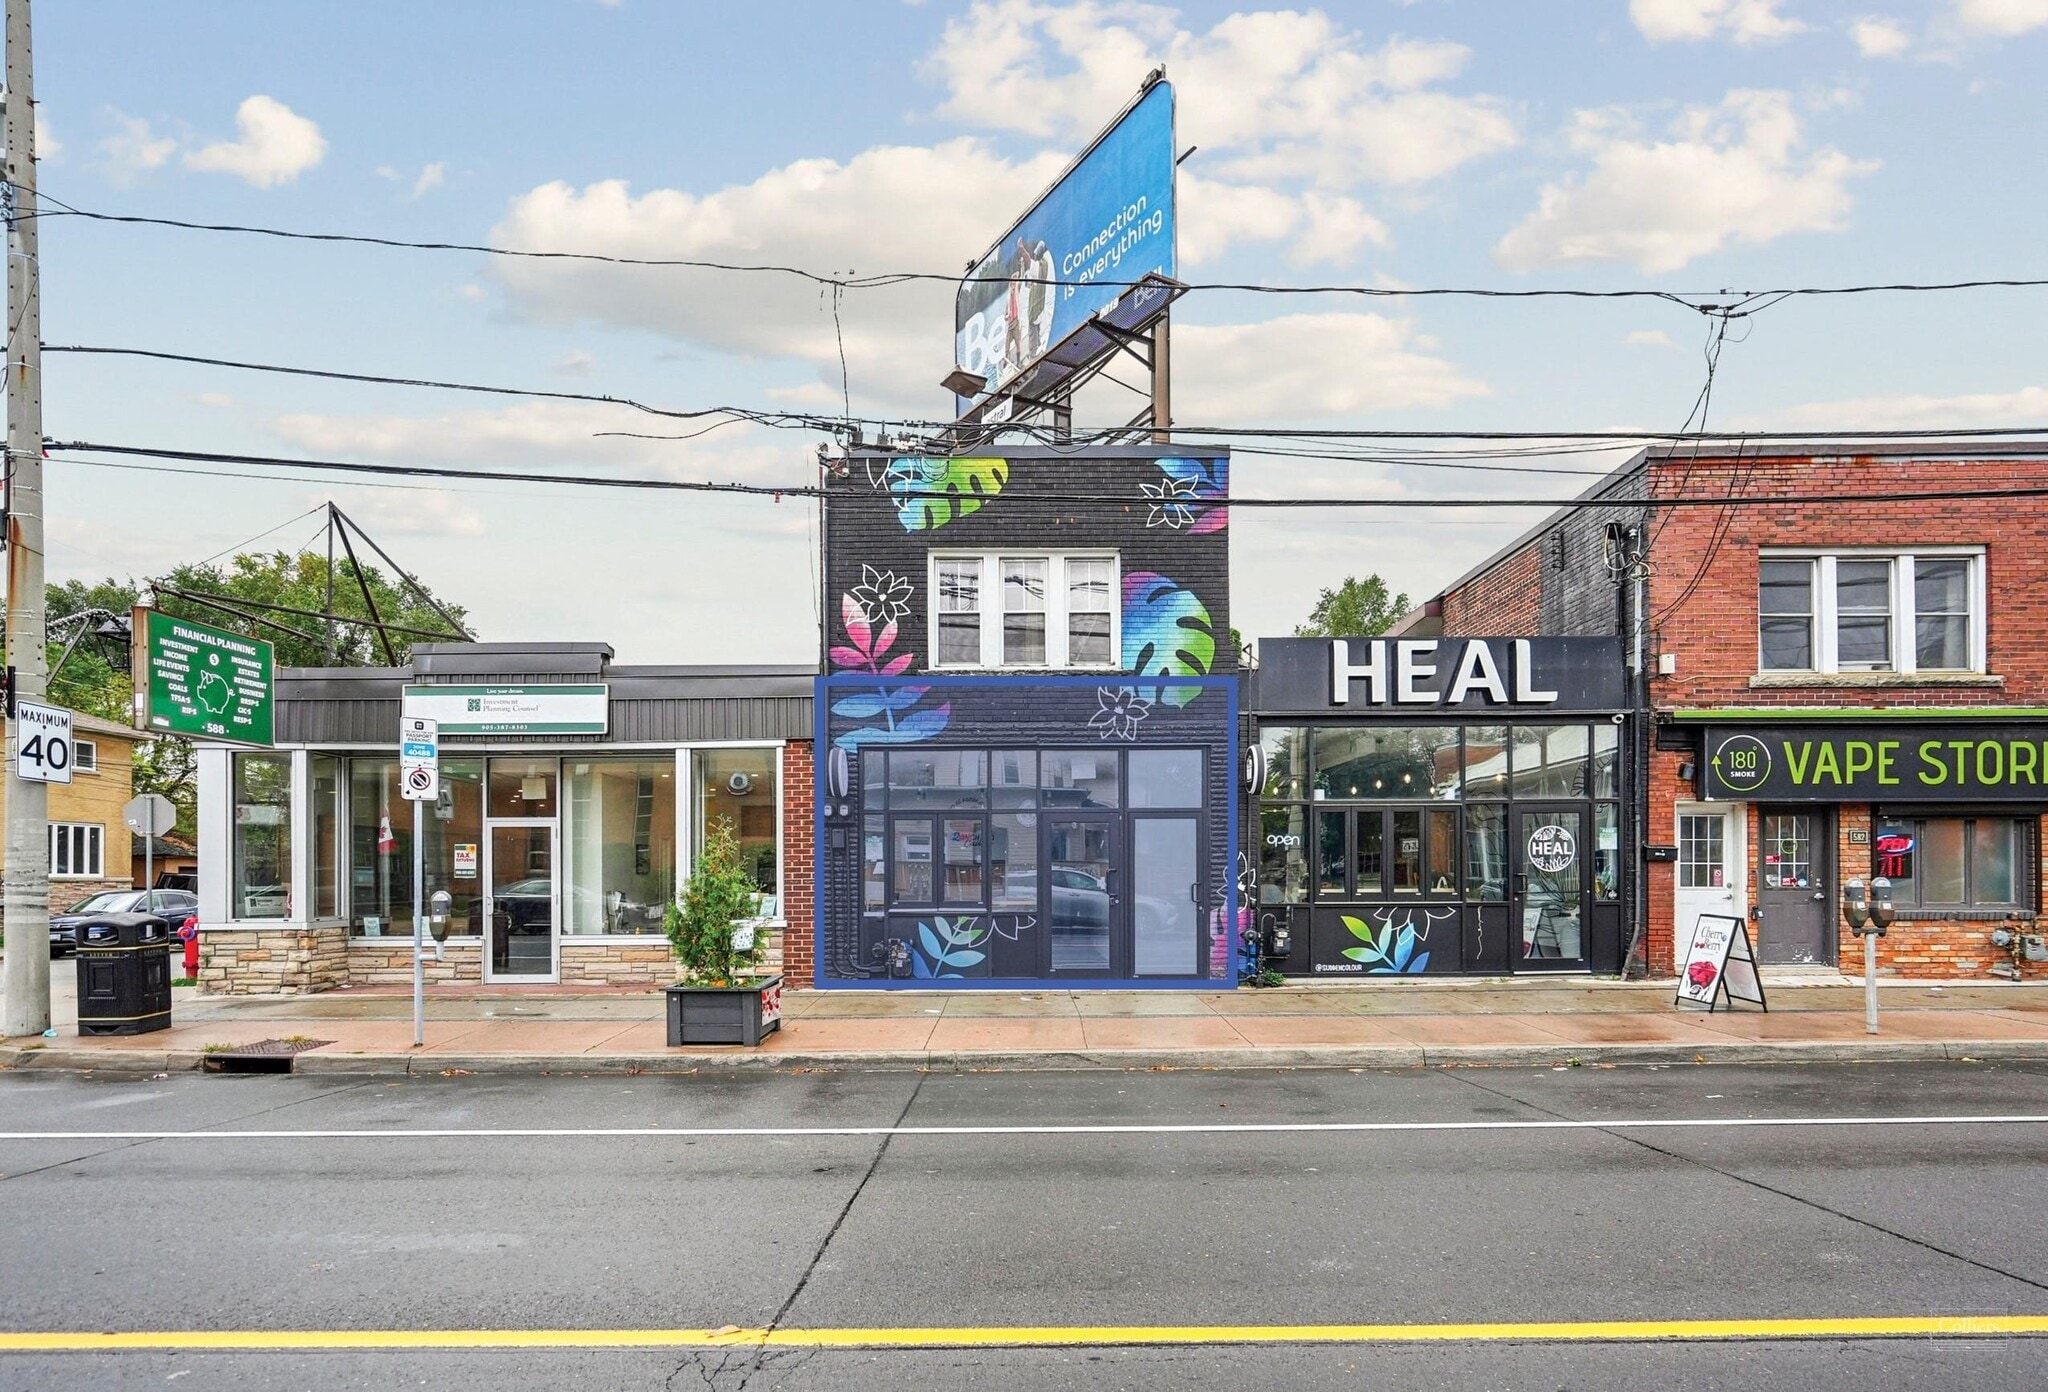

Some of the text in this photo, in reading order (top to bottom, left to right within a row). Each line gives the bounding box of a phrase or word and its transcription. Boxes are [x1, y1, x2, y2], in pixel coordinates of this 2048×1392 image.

[1063, 195, 1146, 275] Connection
[1064, 209, 1162, 301] is everything
[159, 637, 199, 654] INVESTMENT
[173, 626, 256, 656] FINANCIAL PLANNING
[163, 649, 188, 662] INCOME
[231, 655, 262, 670] INSURANCE
[153, 657, 190, 672] LIFE EVENTS
[1333, 639, 1558, 703] HEAL
[157, 669, 184, 682] SAVINGS
[238, 667, 260, 678] ESTATES
[168, 682, 188, 693] GOALS
[233, 676, 267, 690] RETIREMENT
[239, 687, 265, 699] BUSINESS
[20, 709, 68, 728] MAXIMUM
[206, 722, 225, 735] 588
[406, 732, 433, 740] PASSPORT
[20, 734, 68, 770] 40
[1783, 740, 2048, 785] VAPE STOR
[1266, 834, 1300, 848] open
[1532, 841, 1572, 855] HEAL
[1704, 938, 1721, 954] Berry
